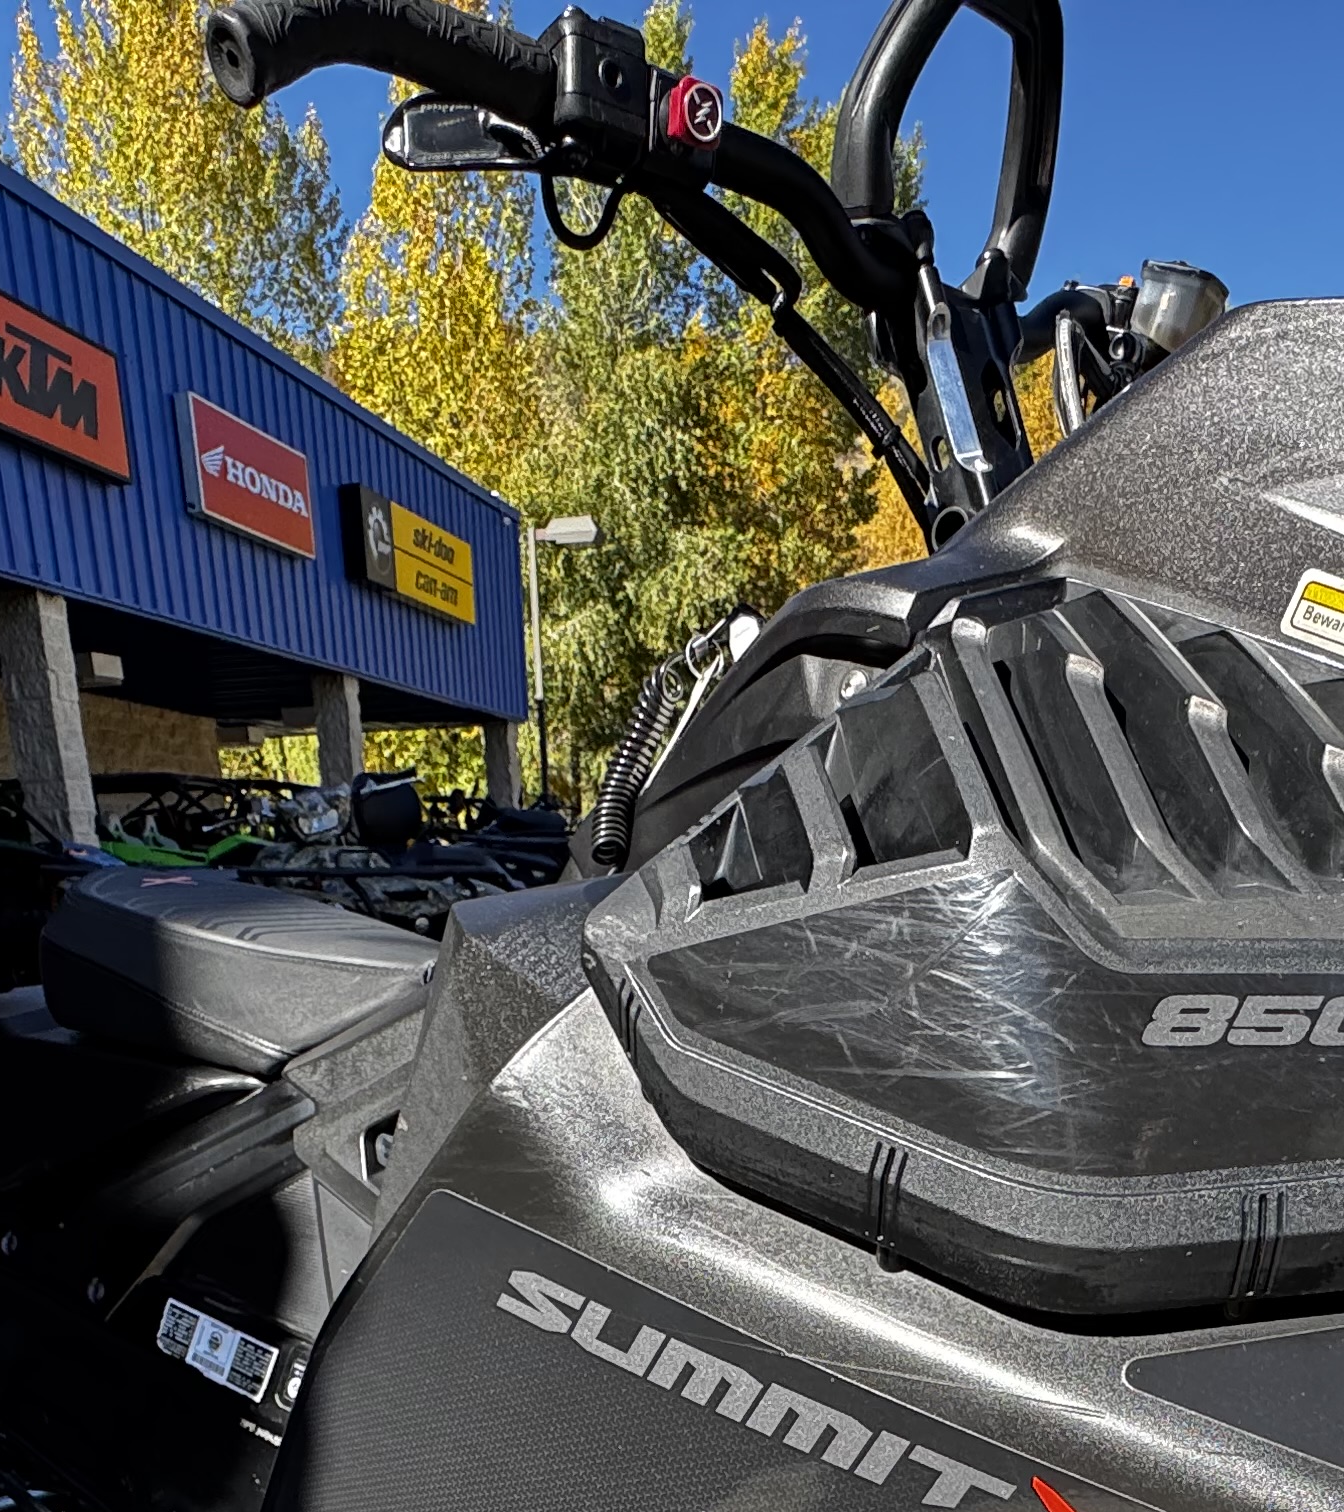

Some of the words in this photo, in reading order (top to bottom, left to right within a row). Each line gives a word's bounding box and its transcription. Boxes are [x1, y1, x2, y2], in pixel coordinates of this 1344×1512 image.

[224, 455, 309, 518] HONDA
[413, 527, 455, 565] ski-doo
[415, 570, 458, 607] can-am
[496, 1269, 1017, 1508] SUMMIT
